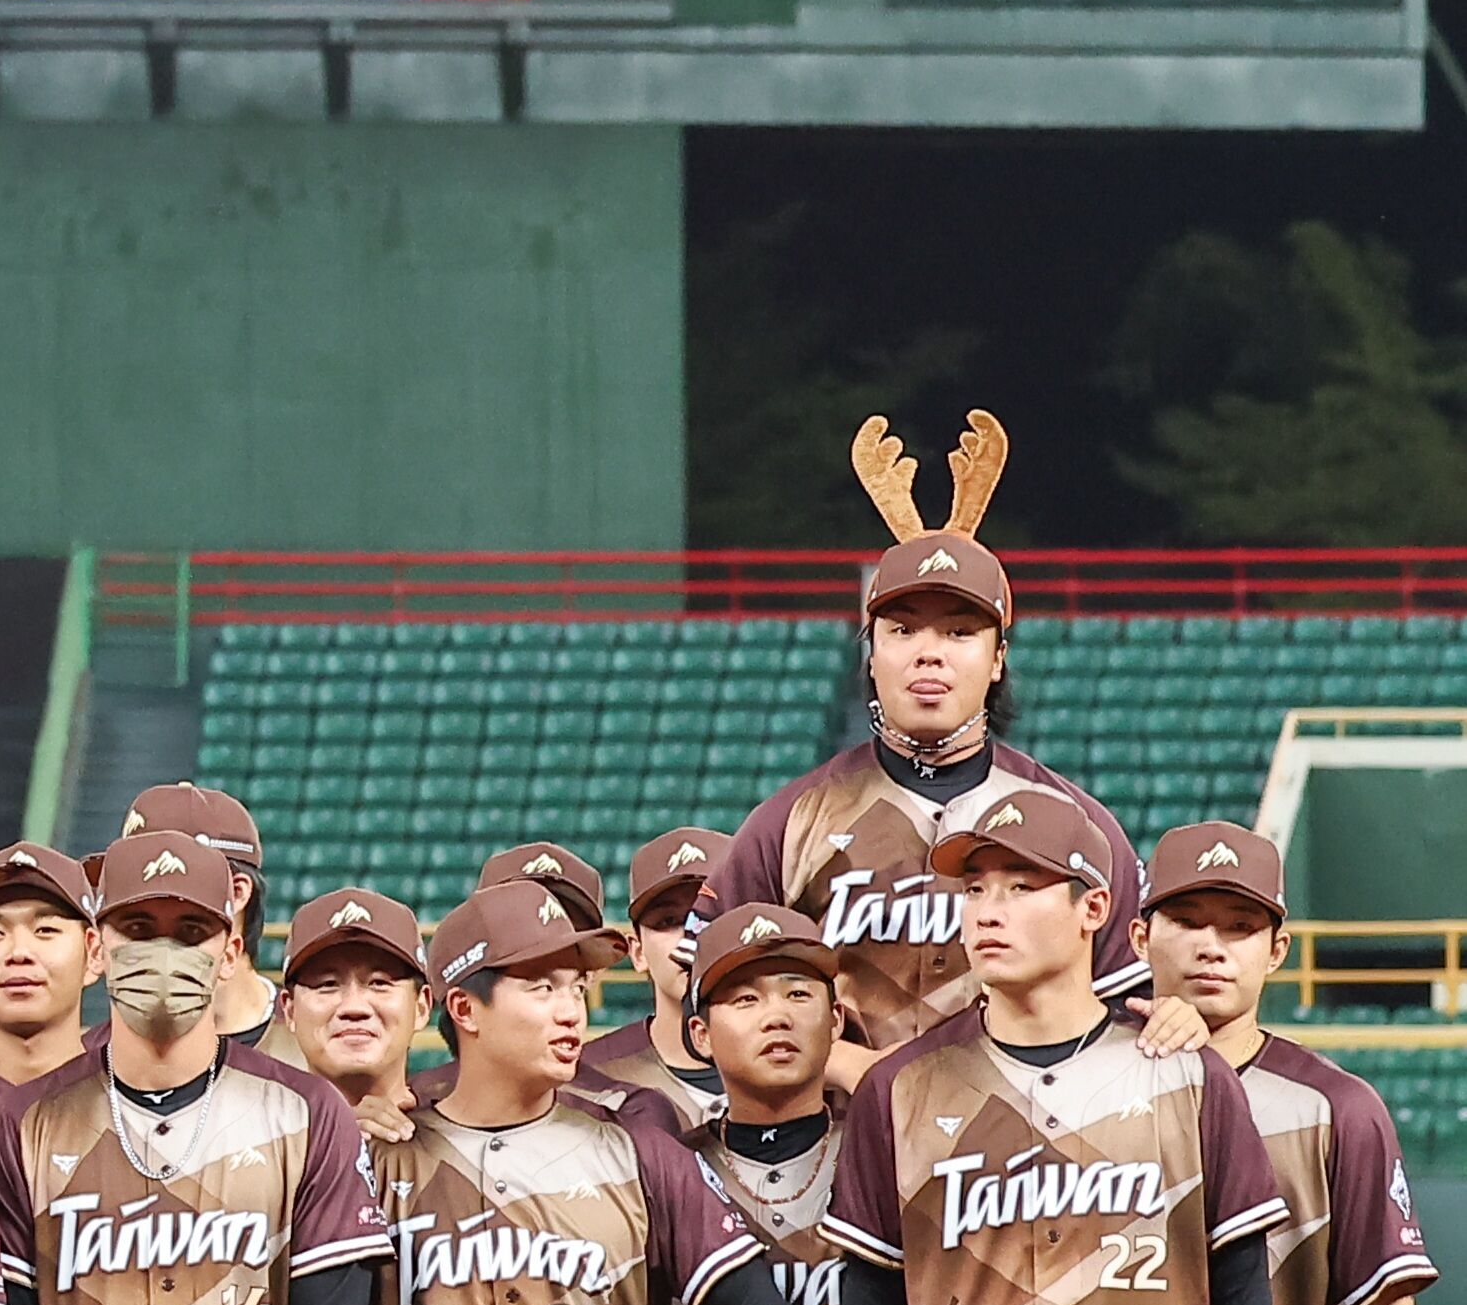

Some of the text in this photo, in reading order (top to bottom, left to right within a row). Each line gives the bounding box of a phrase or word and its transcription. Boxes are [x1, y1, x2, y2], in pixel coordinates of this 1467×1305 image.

[823, 868, 967, 951] Taiw
[49, 1192, 271, 1293] Taiwan
[934, 1142, 1166, 1251] Taiwan
[1099, 1233, 1168, 1292] 22
